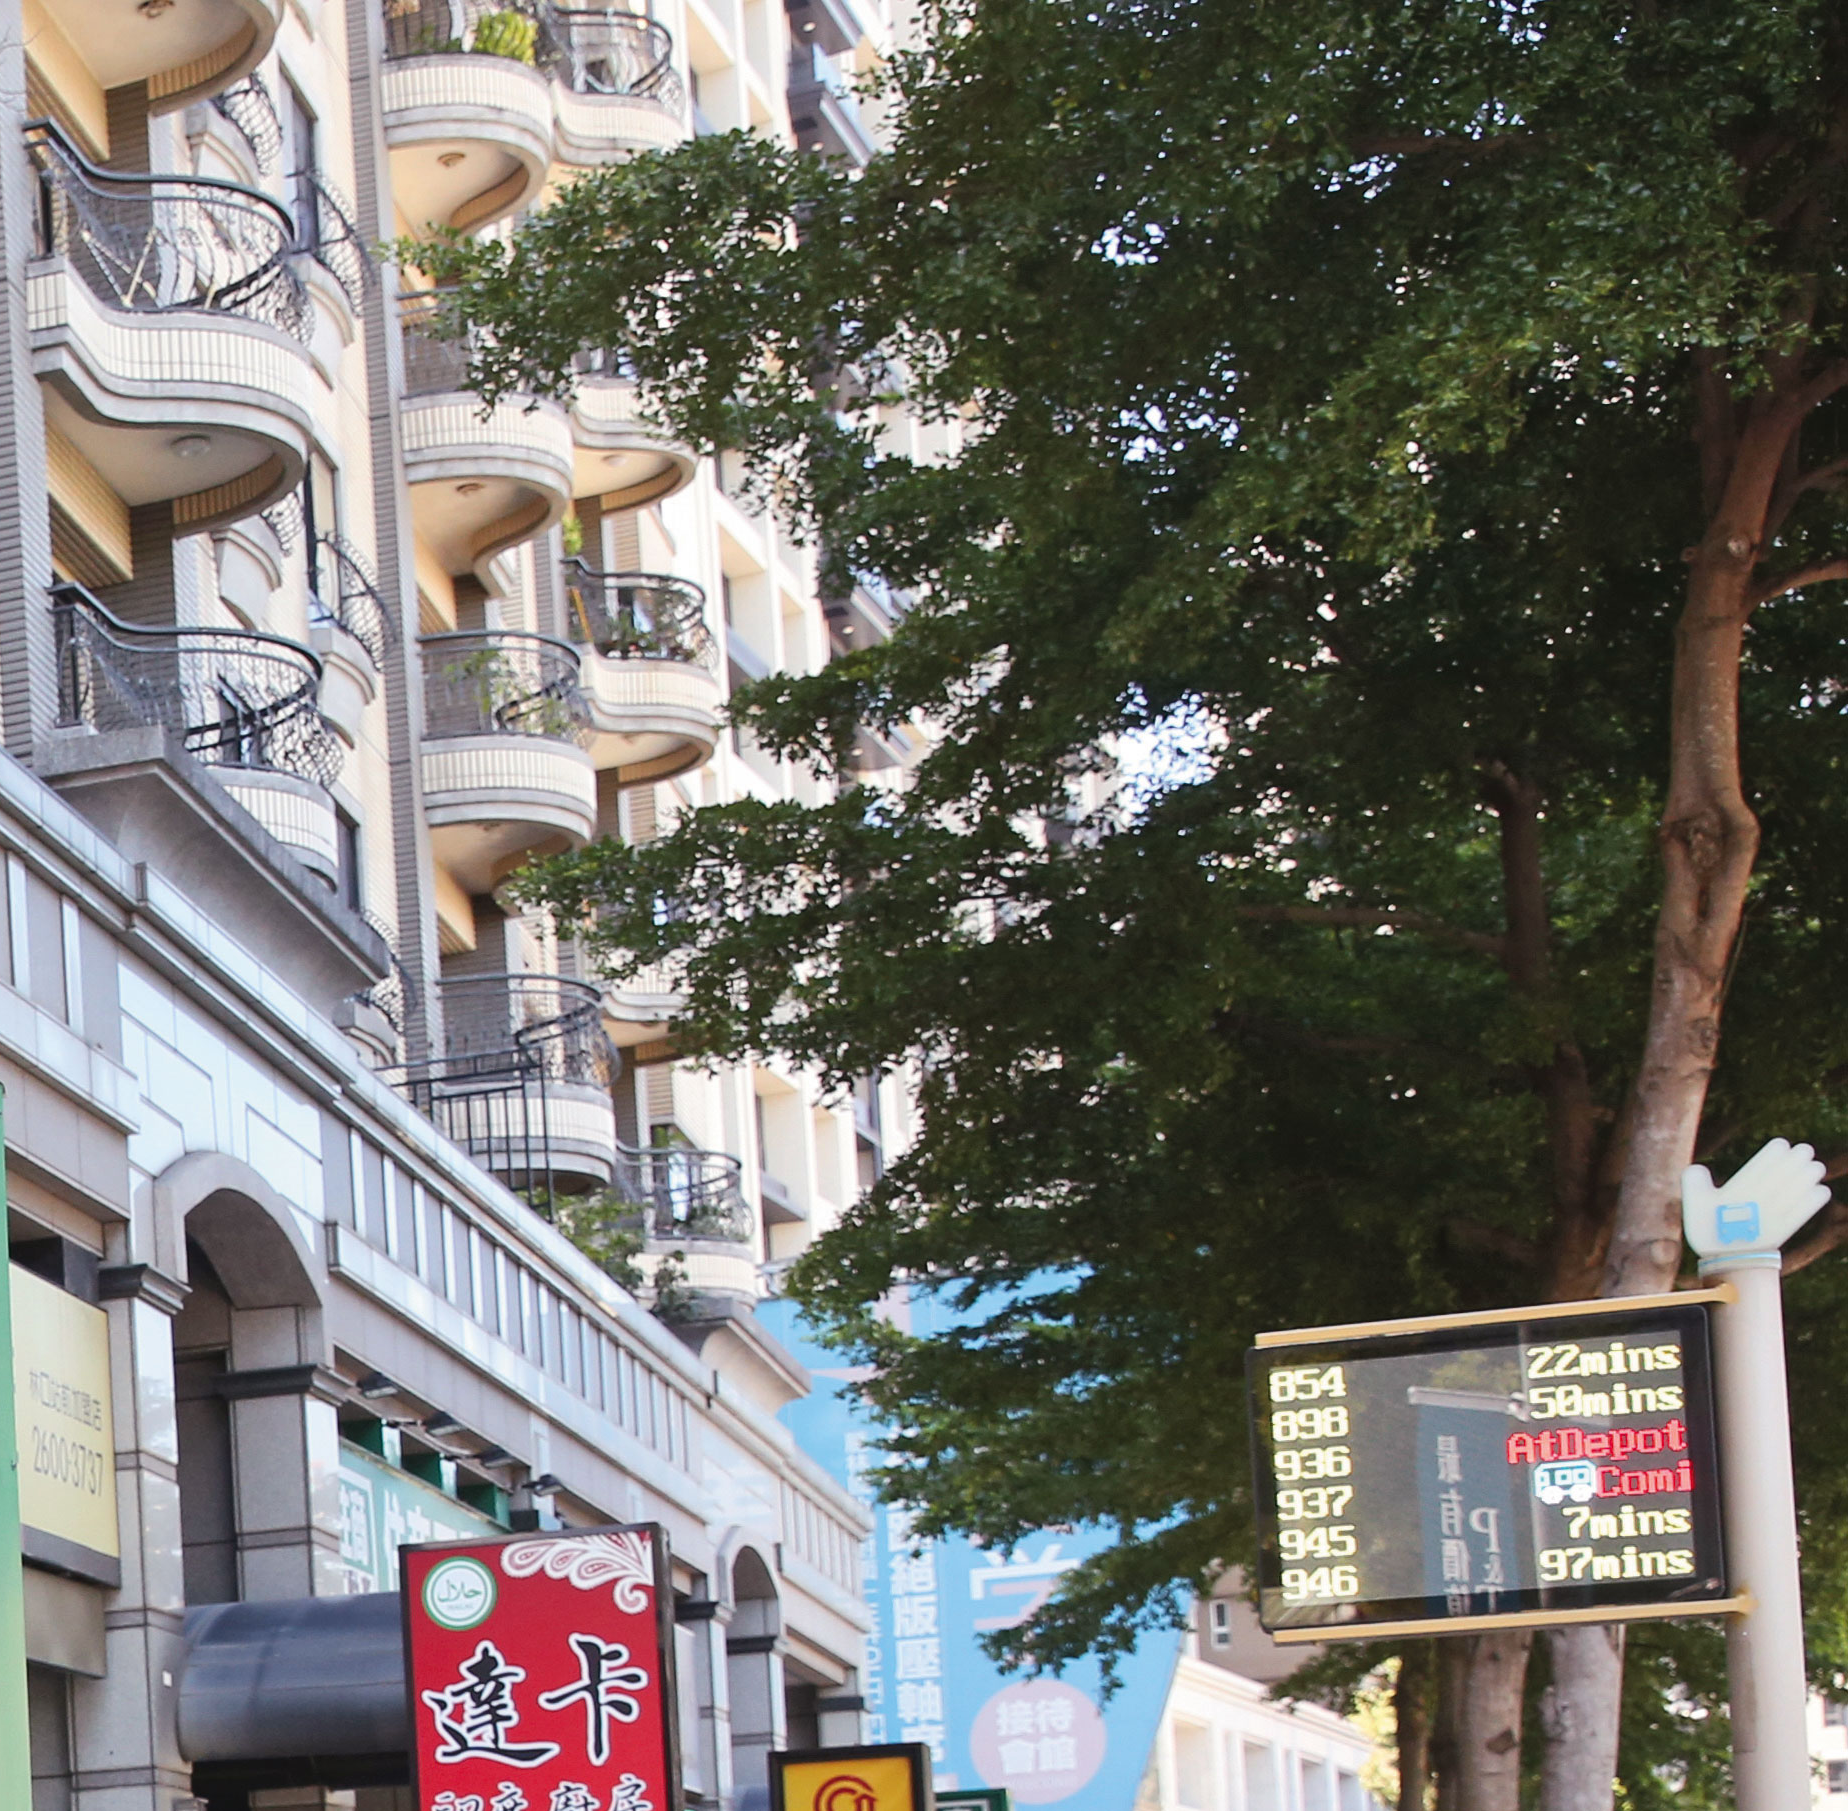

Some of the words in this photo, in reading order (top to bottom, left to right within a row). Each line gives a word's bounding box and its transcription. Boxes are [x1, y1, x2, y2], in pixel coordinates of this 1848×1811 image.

[1269, 1364, 1347, 1403] 854
[1525, 1341, 1682, 1380] 22mins
[1271, 1405, 1349, 1443] 898
[1528, 1382, 1685, 1420] 50mins
[1273, 1445, 1352, 1482] 936
[1507, 1418, 1688, 1465] AtDepot
[1276, 1484, 1354, 1521] 937
[1595, 1459, 1695, 1498] Comi
[1279, 1524, 1358, 1562] 945
[1563, 1504, 1692, 1541] 7mins
[1281, 1564, 1359, 1602] 946
[1539, 1544, 1696, 1583] 97mins
[422, 1632, 648, 1769] 達卡
